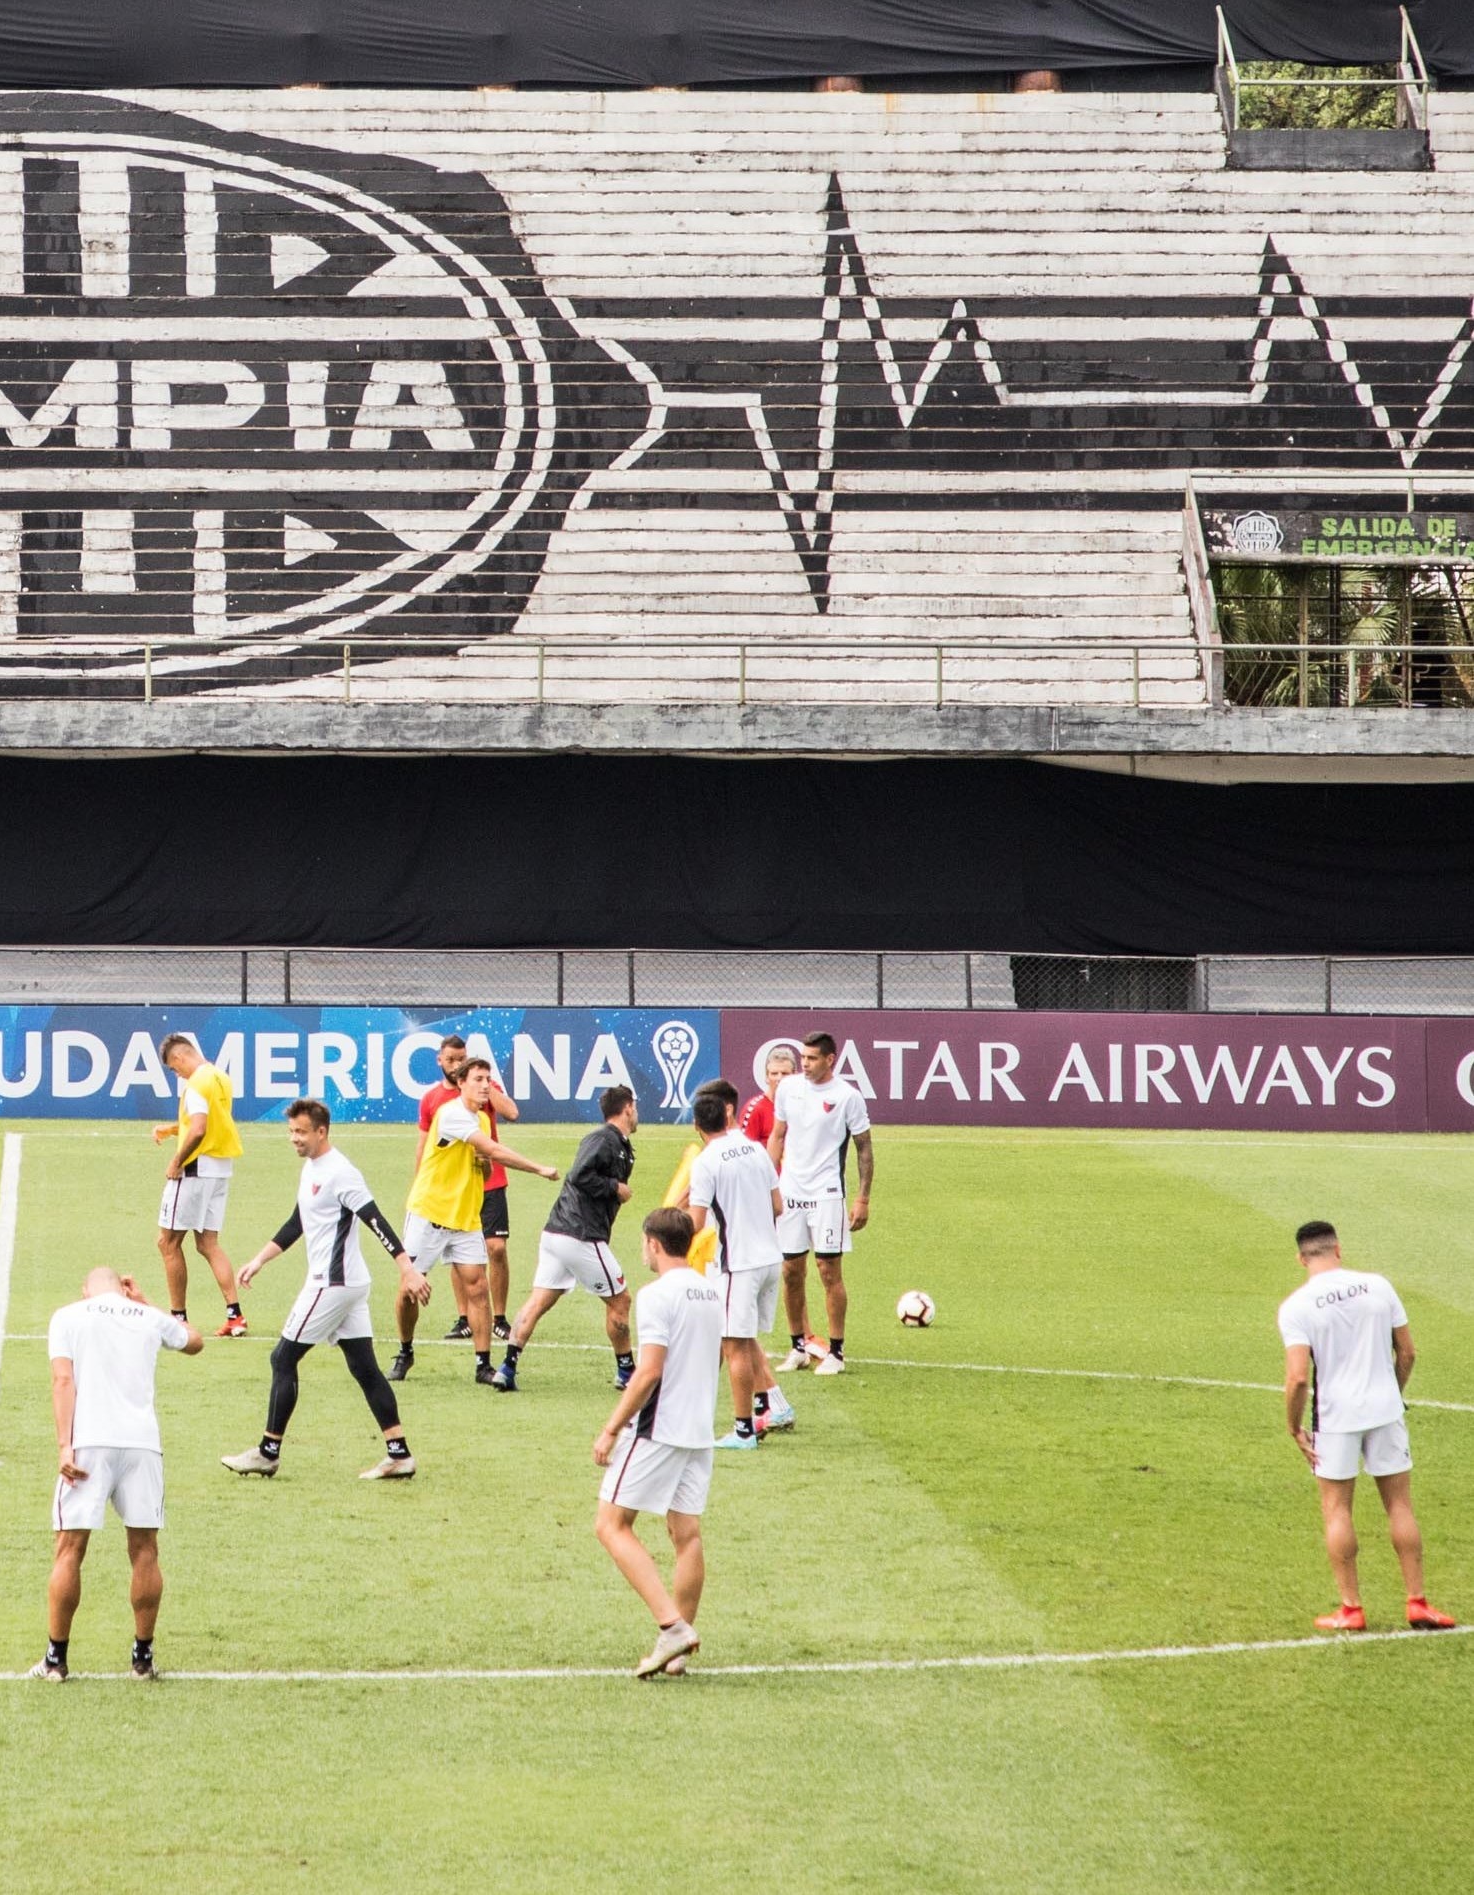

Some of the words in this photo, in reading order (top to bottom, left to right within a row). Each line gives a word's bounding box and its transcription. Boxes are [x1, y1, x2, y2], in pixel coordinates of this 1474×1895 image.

[1322, 518, 1415, 537] SALIDA
[1427, 518, 1457, 537] DE
[1302, 540, 1474, 556] EMERGENCIA
[1048, 1042, 1396, 1107] AIRWAYS
[720, 1144, 756, 1162] COLON
[825, 1228, 834, 1245] 2
[686, 1287, 719, 1302] COLON
[1316, 1283, 1369, 1309] COLON
[86, 1303, 145, 1318] COLON
